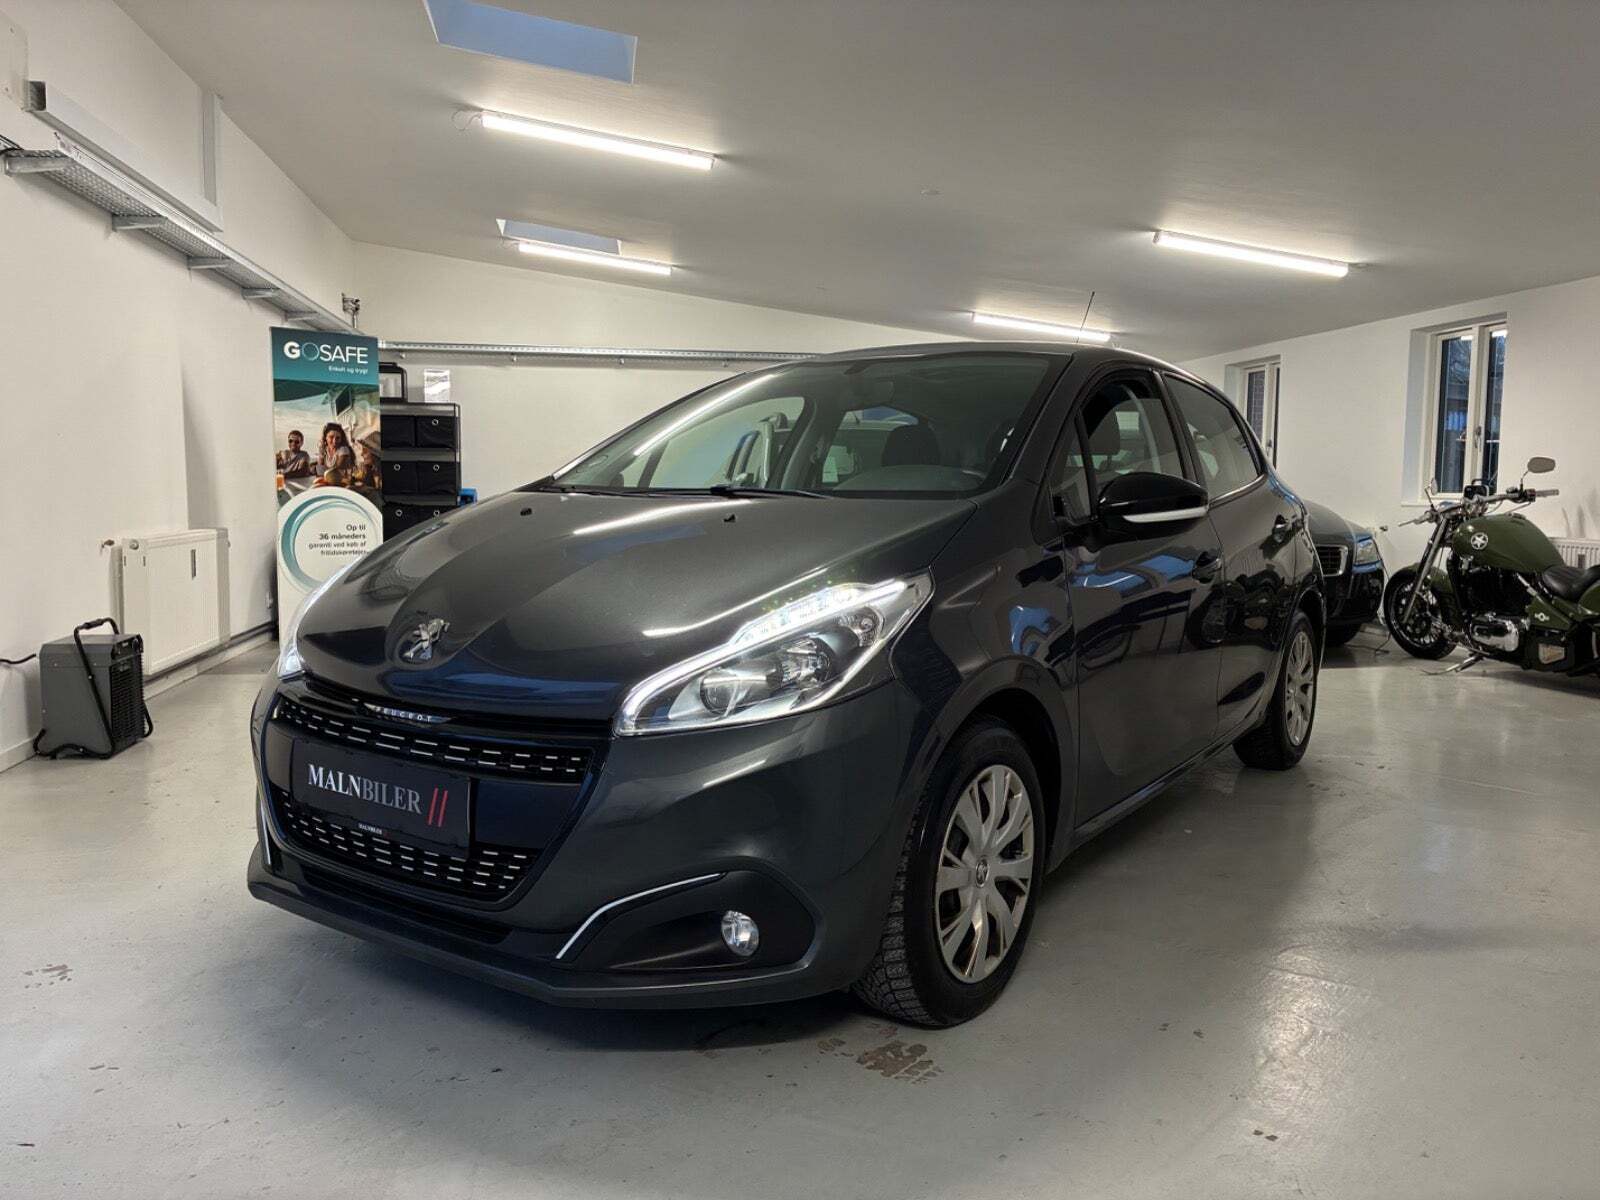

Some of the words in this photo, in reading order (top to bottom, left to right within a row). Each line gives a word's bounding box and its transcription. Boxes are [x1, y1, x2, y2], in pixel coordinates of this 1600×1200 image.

[284, 341, 368, 364] GOSAFE
[331, 532, 366, 540] måneders
[308, 764, 423, 814] MALNBILER
